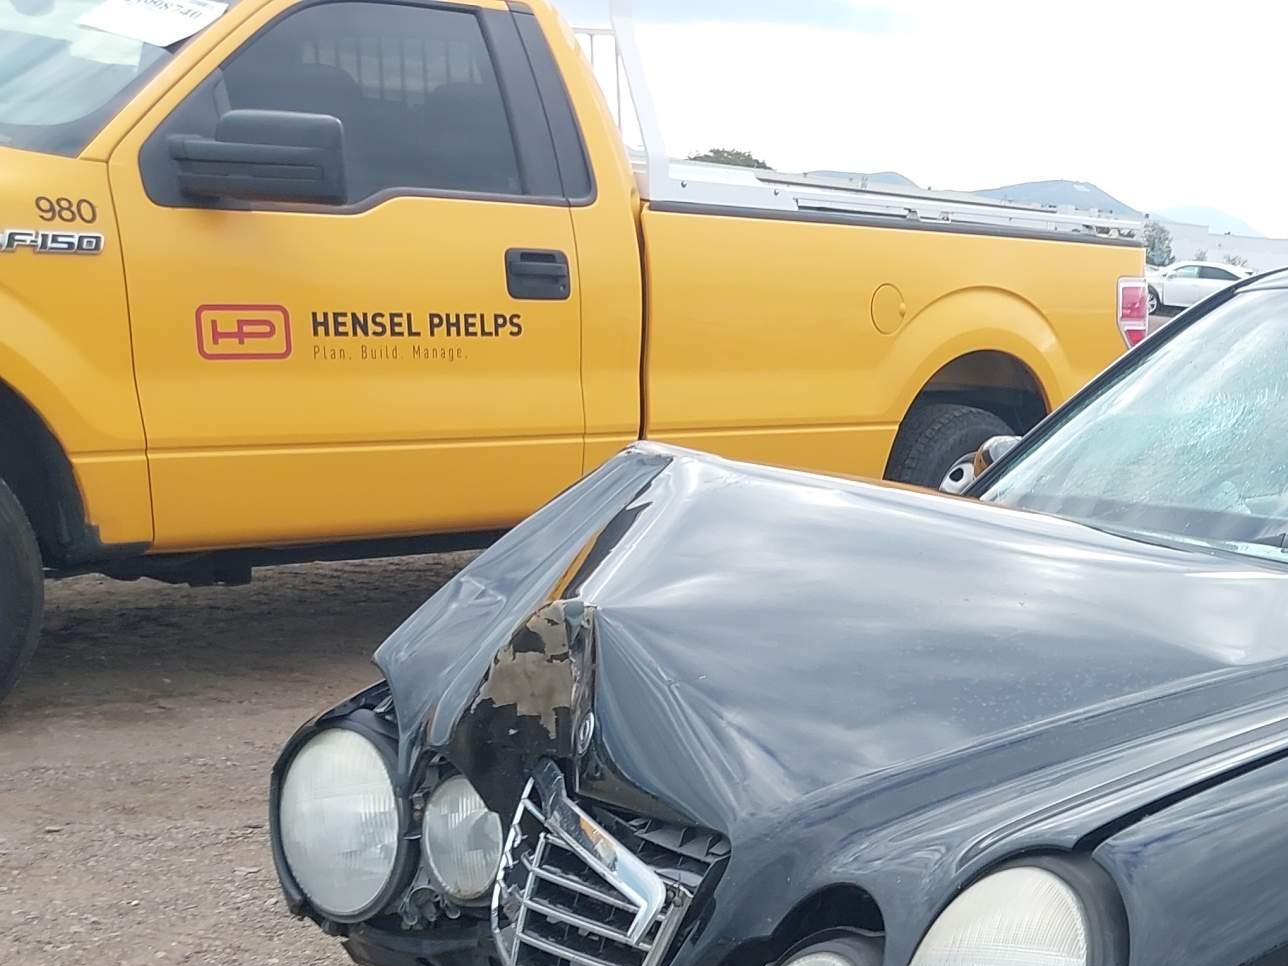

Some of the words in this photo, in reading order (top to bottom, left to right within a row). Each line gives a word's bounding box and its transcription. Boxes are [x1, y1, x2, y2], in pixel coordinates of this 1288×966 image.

[35, 196, 97, 224] 980
[4, 229, 104, 253] F-150
[210, 318, 277, 345] HP
[311, 311, 421, 337] HENSEL
[429, 313, 523, 337] PHELPS
[313, 345, 352, 361] Plan.
[413, 346, 468, 362] Manage.
